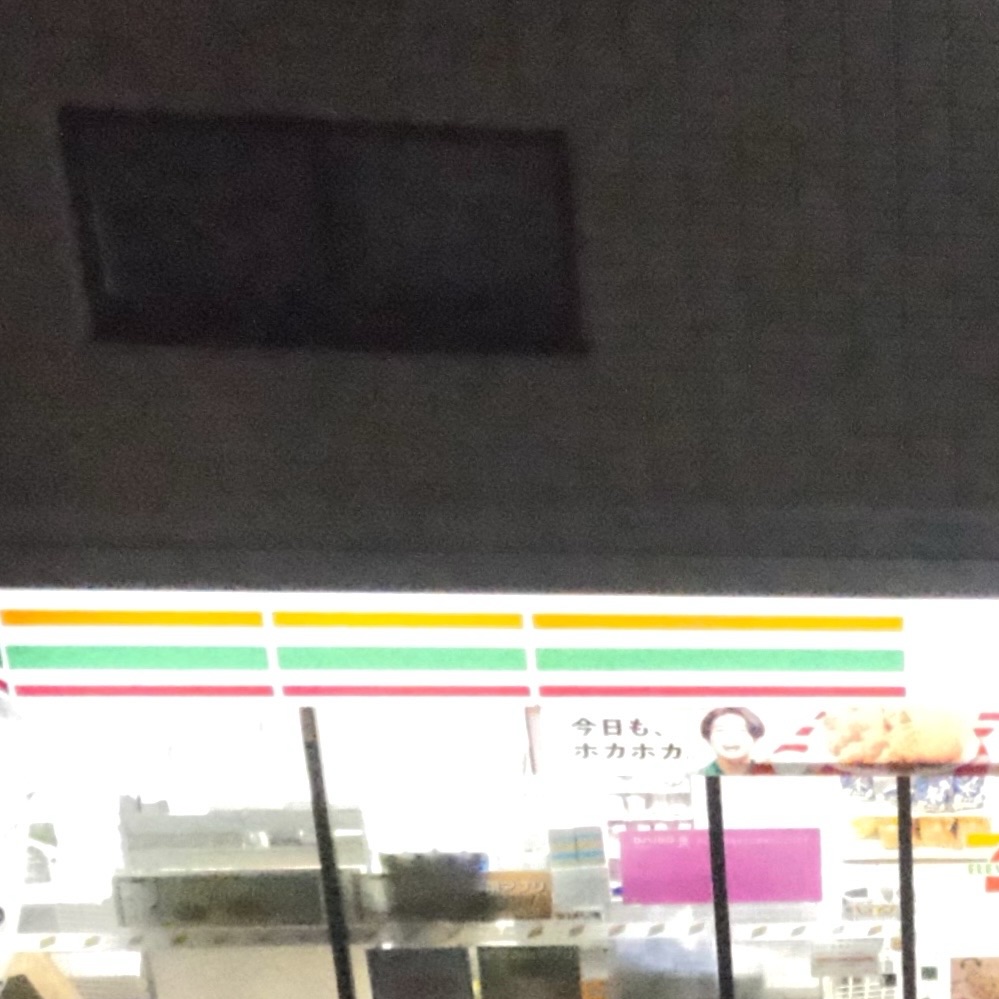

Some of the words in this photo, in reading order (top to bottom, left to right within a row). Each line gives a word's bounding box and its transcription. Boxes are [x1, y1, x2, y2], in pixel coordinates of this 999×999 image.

[571, 717, 662, 737] 今日も、
[574, 742, 682, 760] ホカホカ
